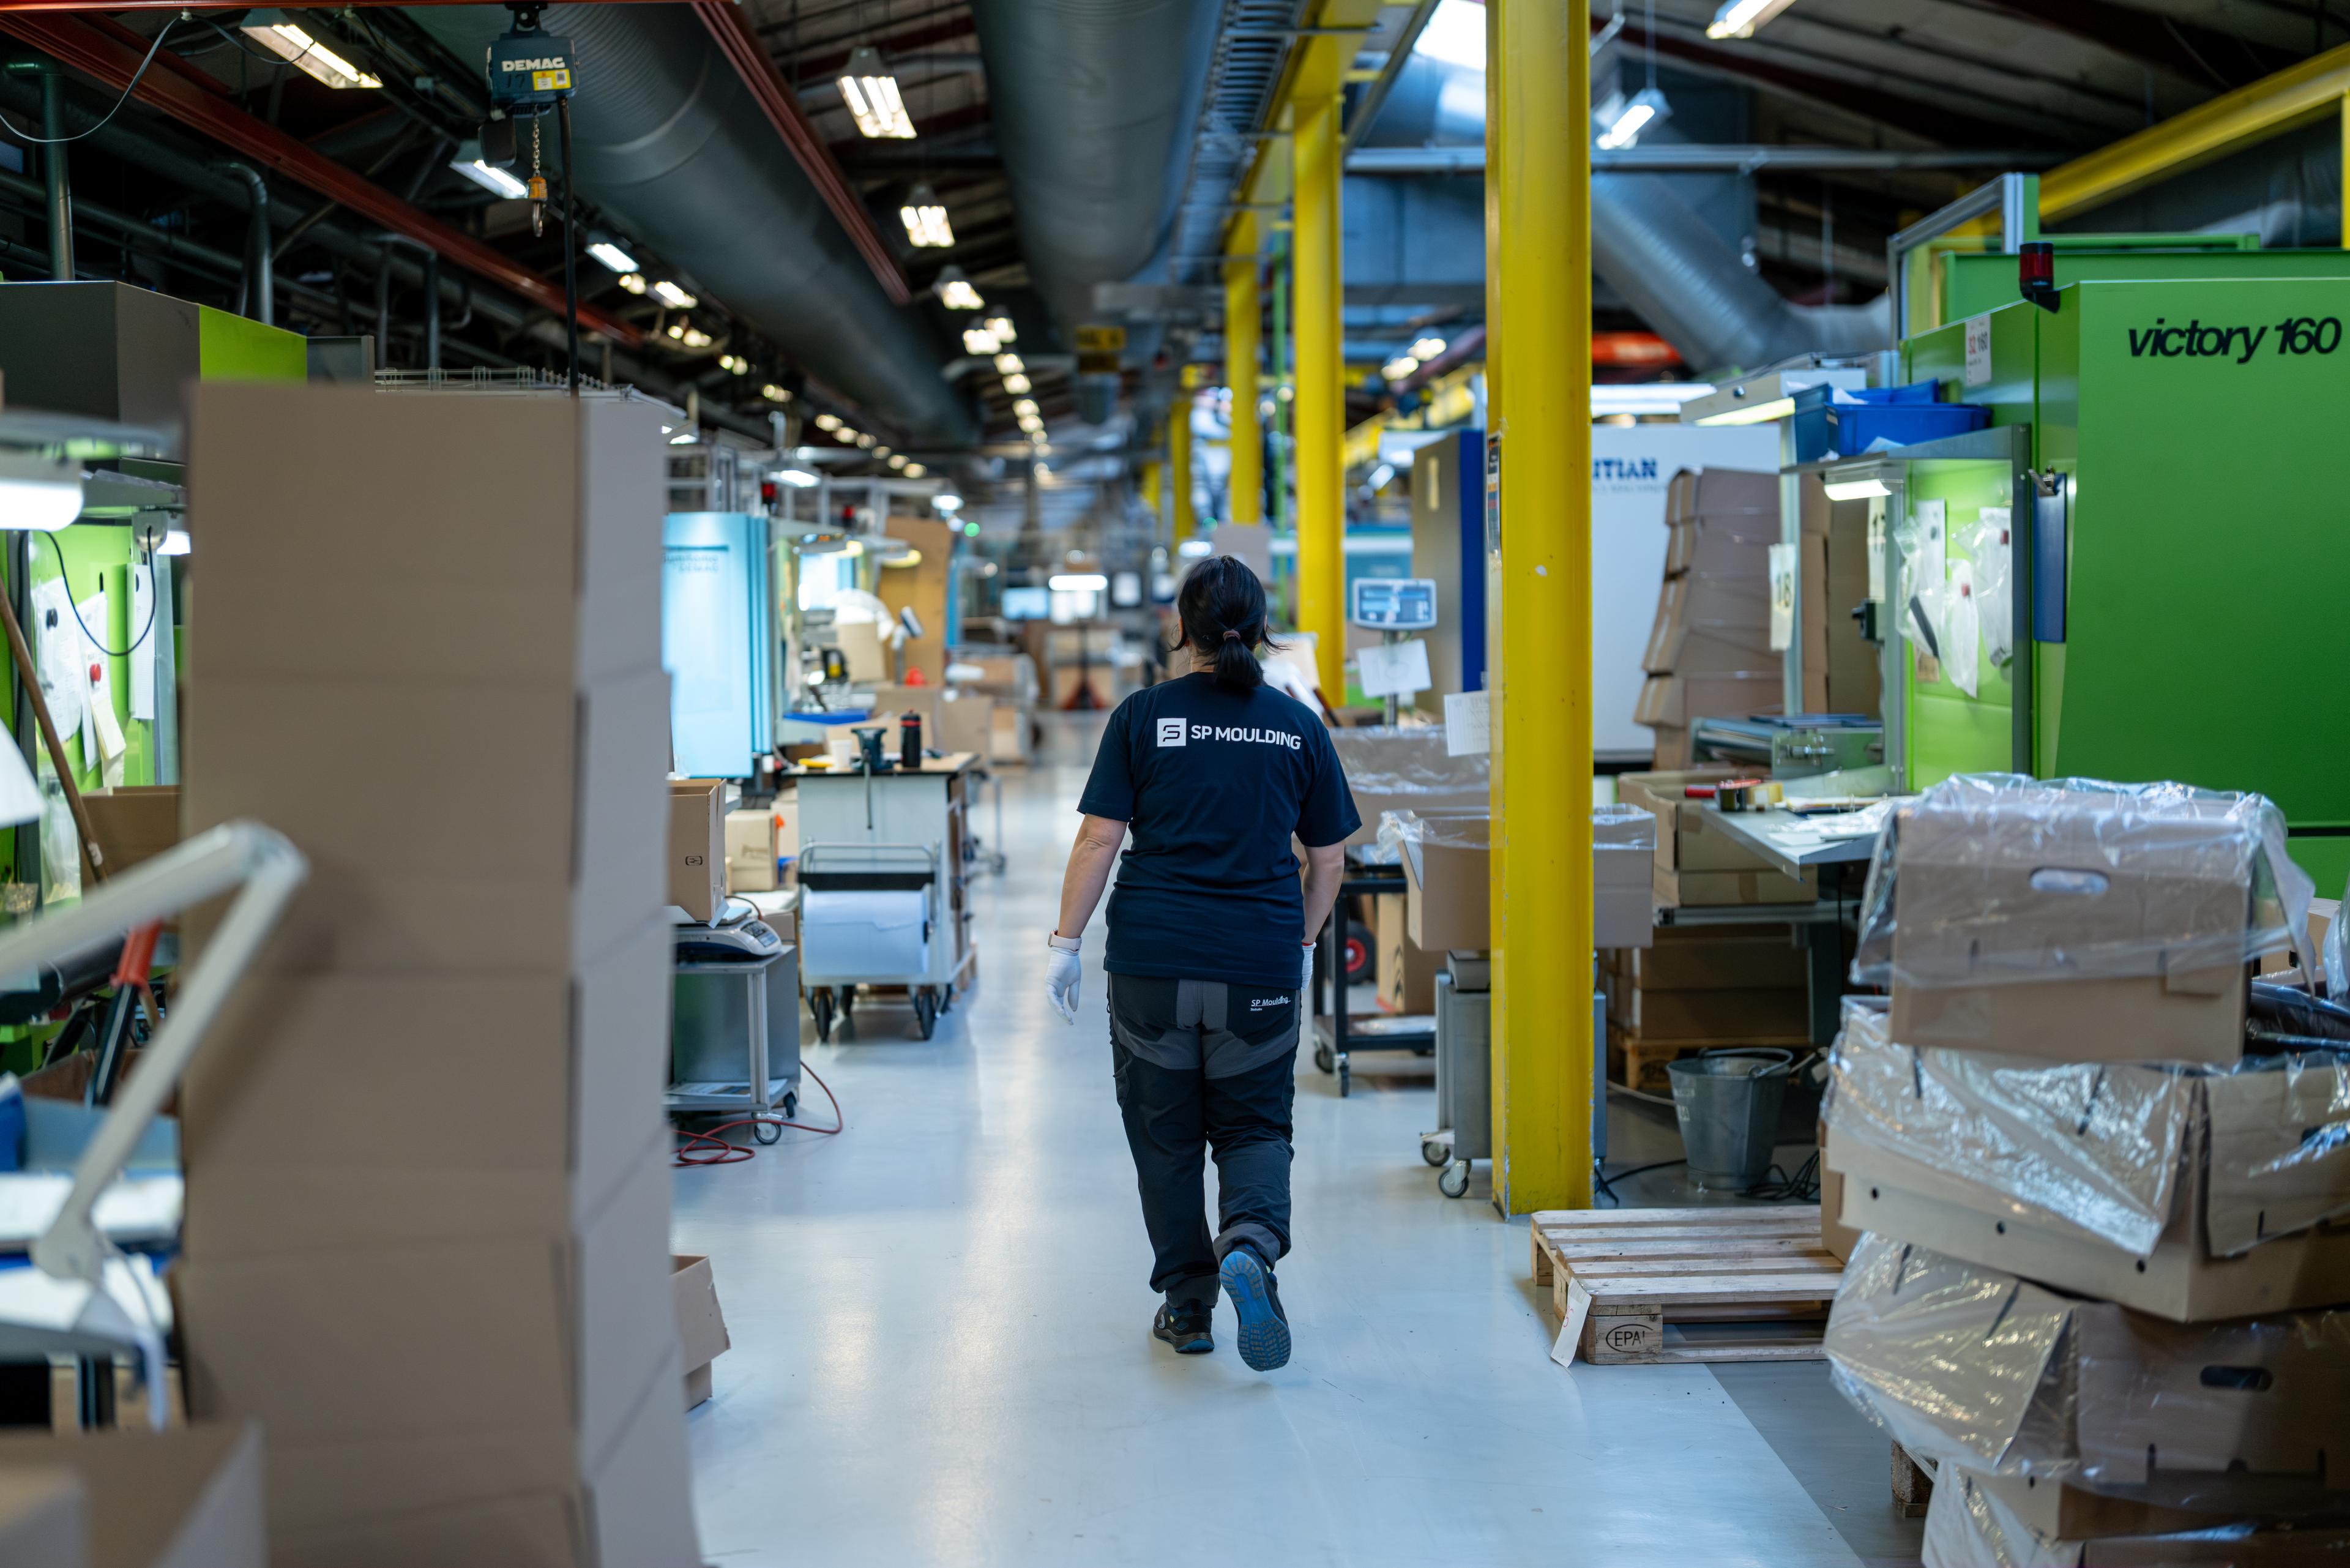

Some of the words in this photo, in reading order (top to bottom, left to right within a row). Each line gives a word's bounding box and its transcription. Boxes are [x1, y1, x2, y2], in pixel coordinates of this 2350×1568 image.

[502, 57, 565, 72] DEMAG
[507, 74, 526, 88] 17
[2128, 318, 2268, 364] victory
[2275, 317, 2342, 355] 160
[1592, 458, 1657, 479] ITIAN
[1191, 725, 1212, 739] SP
[1215, 726, 1302, 750] MOULDING
[1262, 996, 1288, 1006] Moulding
